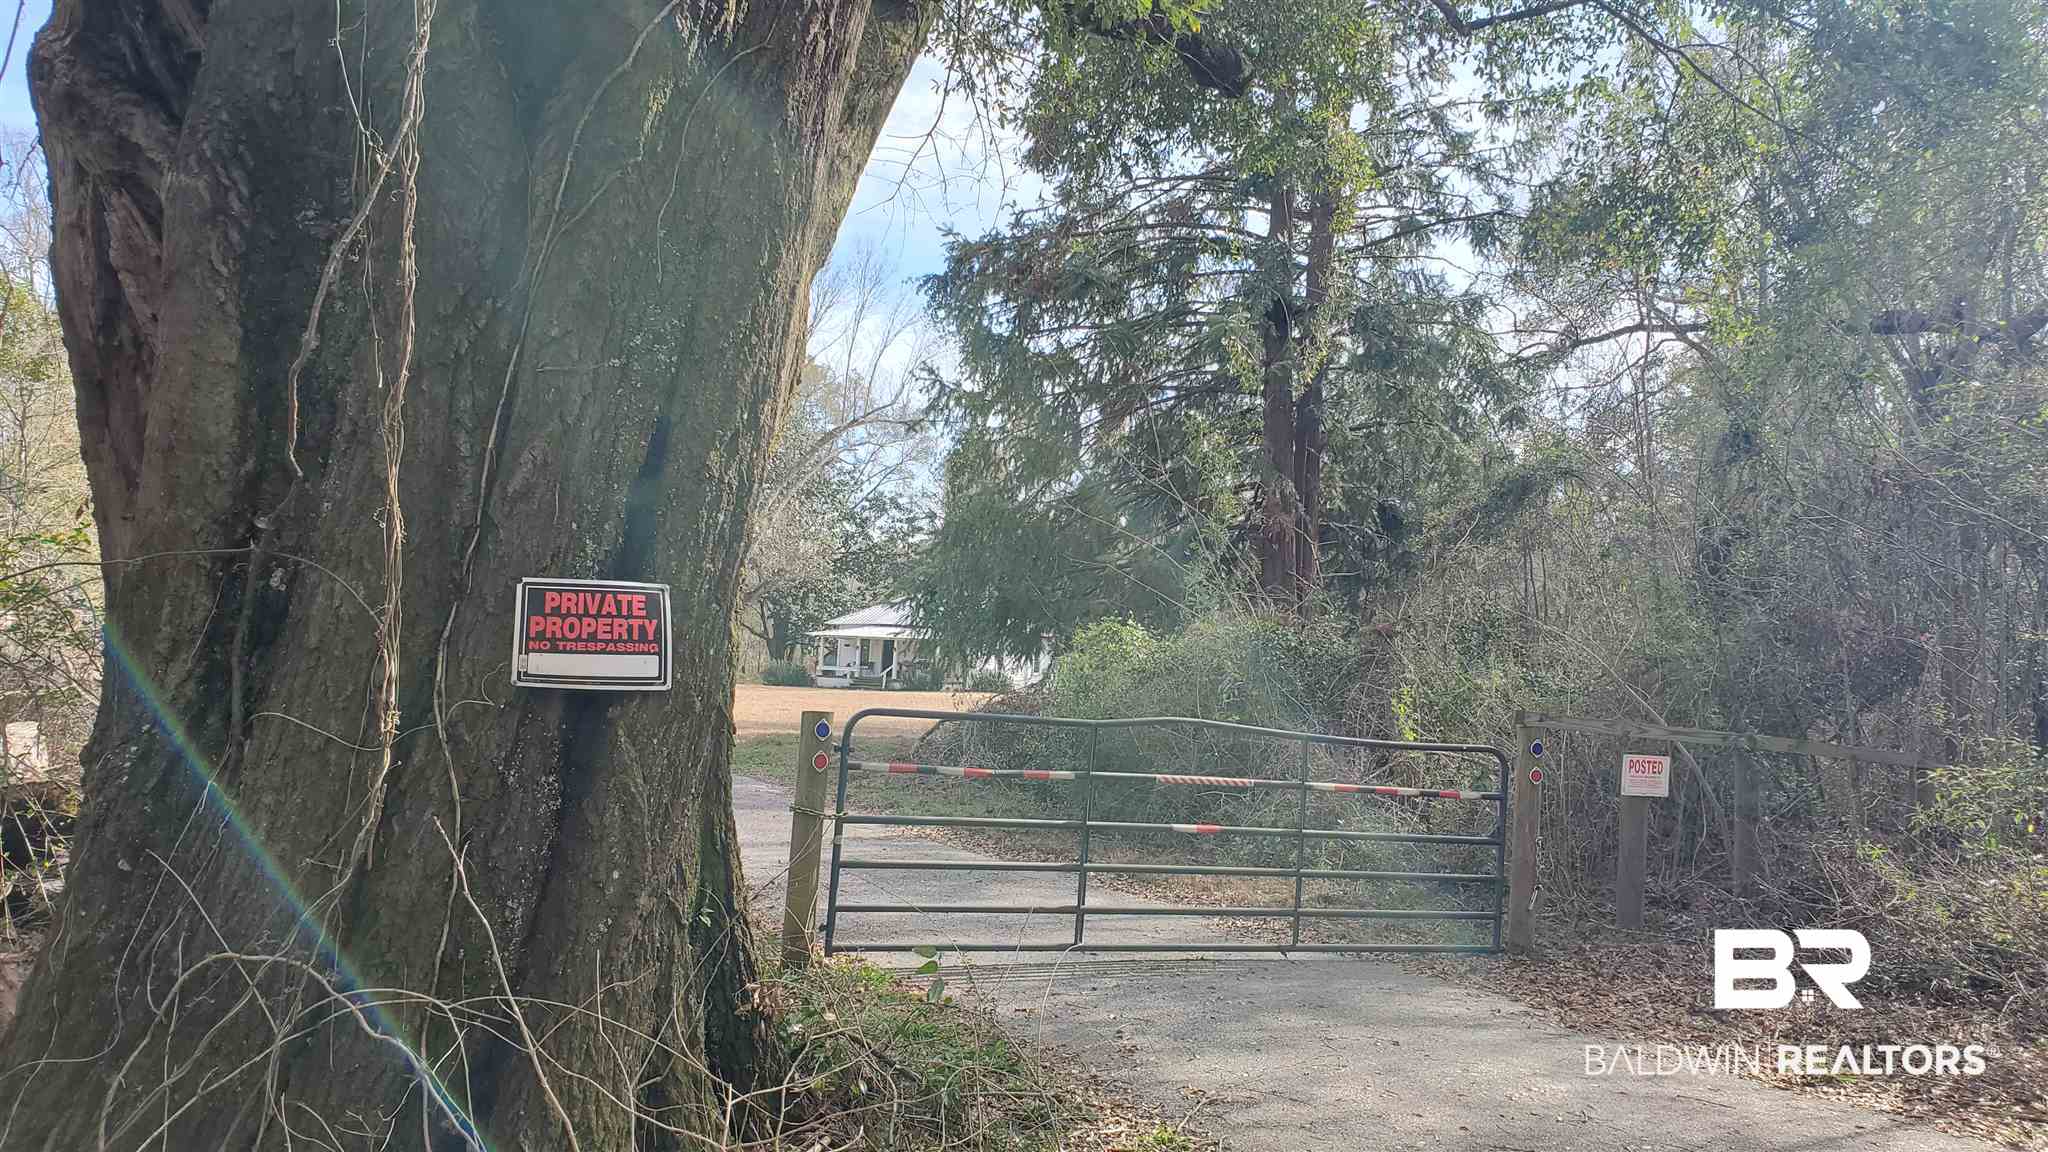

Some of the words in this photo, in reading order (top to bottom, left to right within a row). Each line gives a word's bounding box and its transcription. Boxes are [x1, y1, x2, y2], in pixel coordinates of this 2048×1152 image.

[544, 591, 647, 616] PRIVATE
[529, 616, 658, 640] PROPERTY
[528, 640, 551, 650] NO
[556, 641, 659, 653] TRESPASSING
[1629, 759, 1664, 775] POSTED
